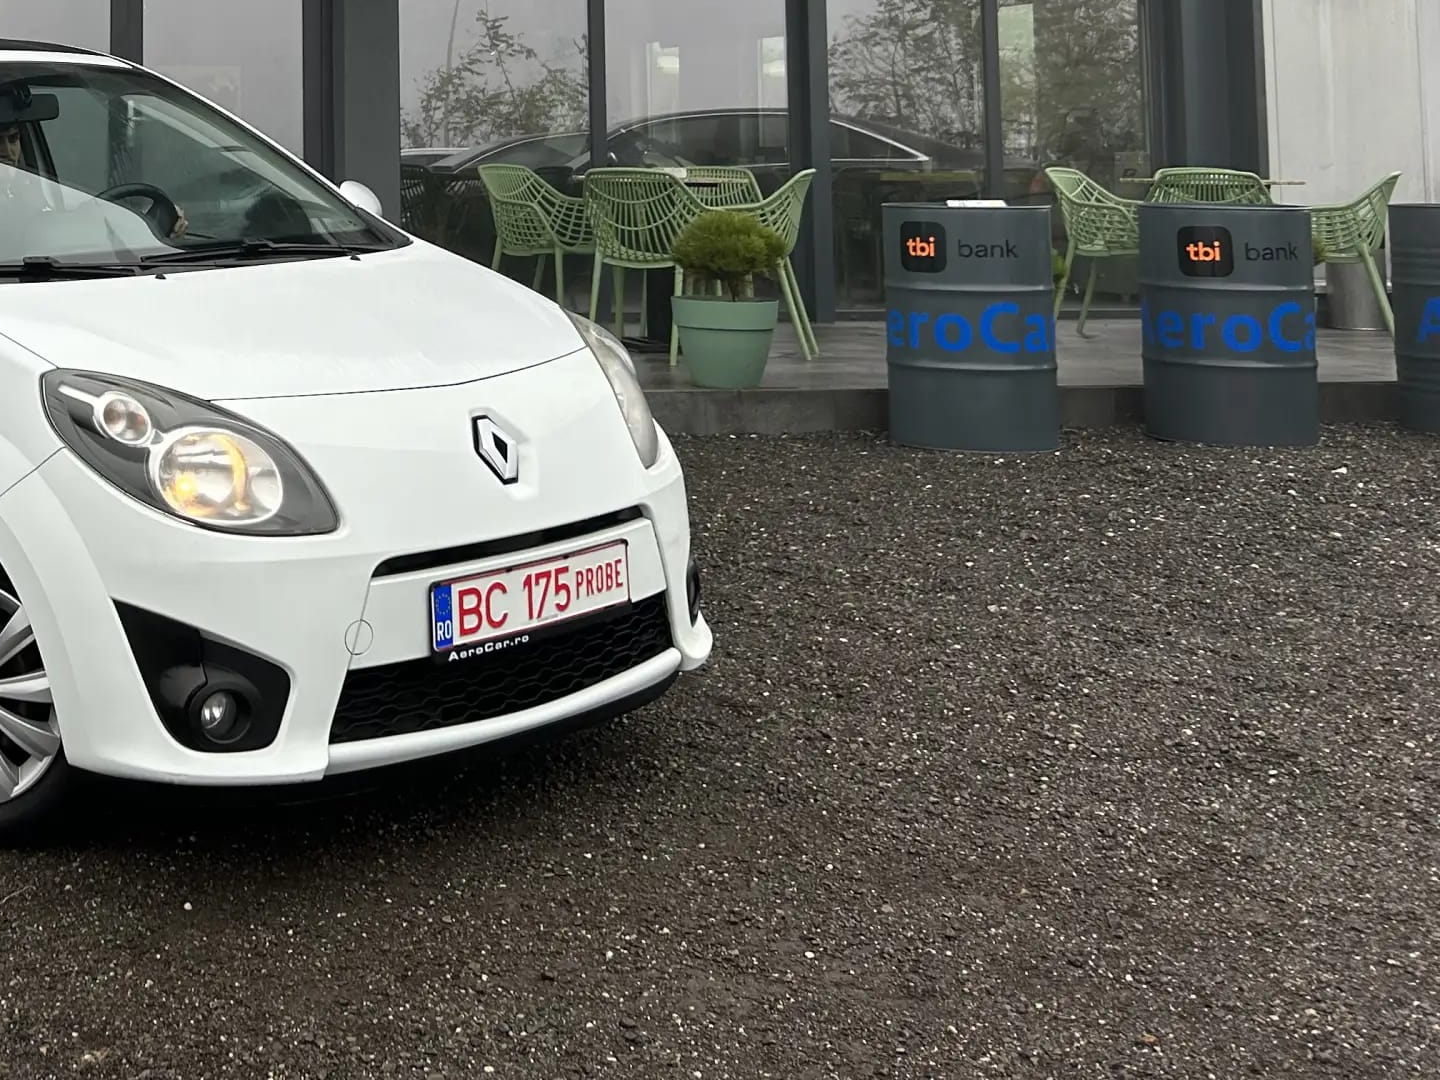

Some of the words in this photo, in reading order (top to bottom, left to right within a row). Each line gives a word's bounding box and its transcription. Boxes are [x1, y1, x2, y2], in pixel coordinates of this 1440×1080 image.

[906, 236, 936, 257] tbi
[957, 239, 1019, 259] bank
[1185, 241, 1222, 261] tbi
[1244, 242, 1300, 261] bank
[436, 619, 453, 642] RO
[458, 582, 509, 637] BC
[523, 565, 572, 621] 175
[575, 558, 624, 600] PROBE
[448, 634, 530, 662] AeroCar.ro
